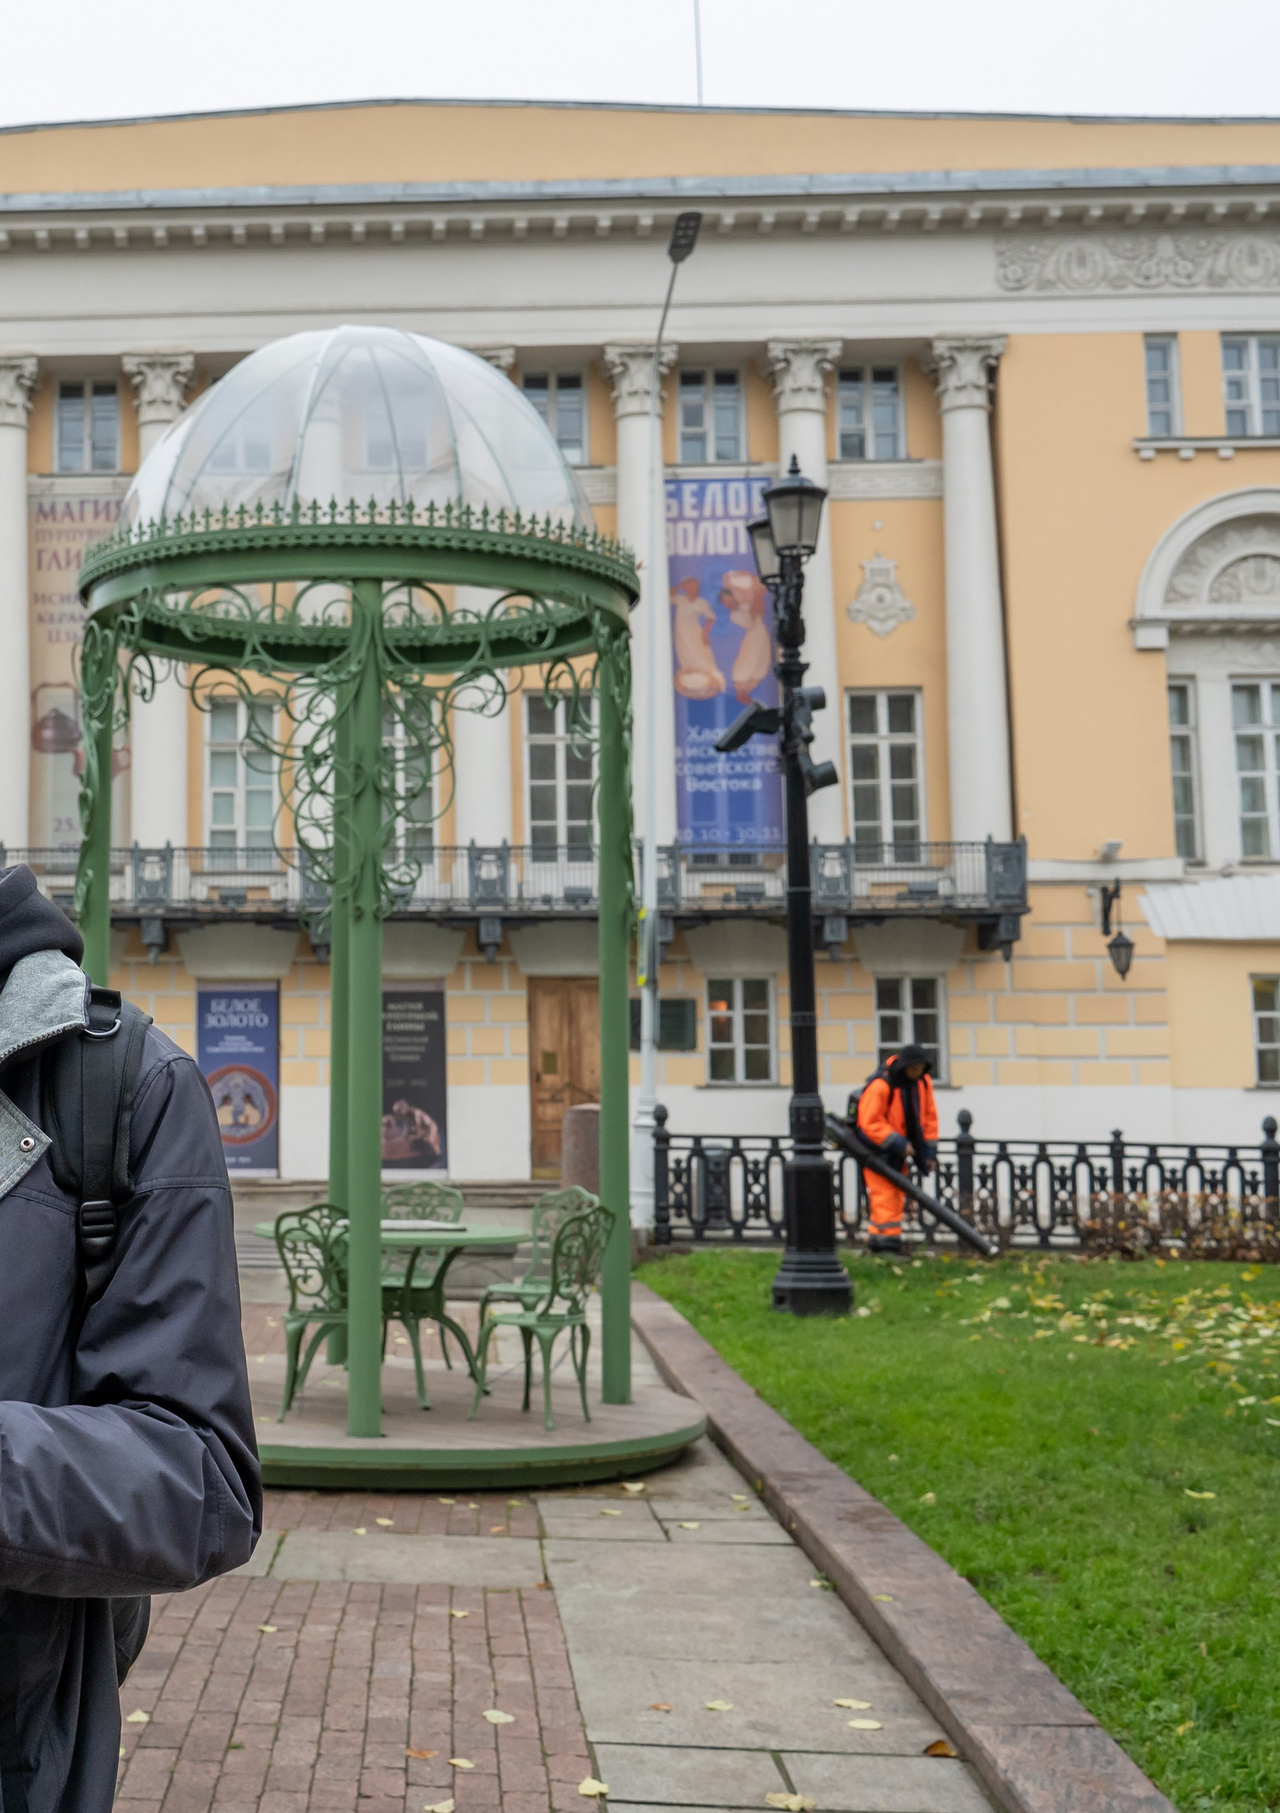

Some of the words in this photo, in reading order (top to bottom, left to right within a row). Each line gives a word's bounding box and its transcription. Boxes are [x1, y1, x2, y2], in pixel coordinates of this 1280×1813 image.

[666, 520, 748, 555] ОЛОТ
[36, 549, 82, 571] ГЛИ
[685, 776, 762, 791] Востока
